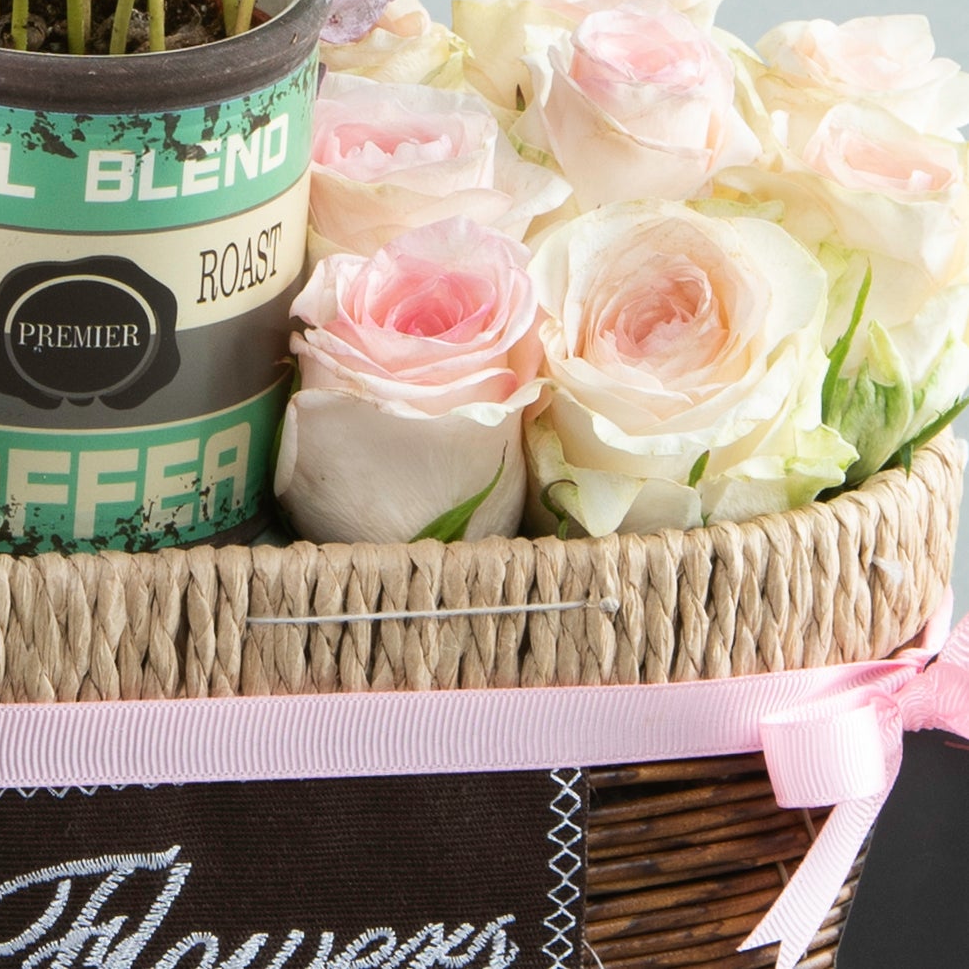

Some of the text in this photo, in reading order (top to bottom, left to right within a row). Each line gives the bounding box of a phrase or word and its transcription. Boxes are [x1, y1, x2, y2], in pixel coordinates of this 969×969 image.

[84, 113, 289, 203] BLEND
[196, 222, 282, 304] ROAST
[17, 321, 141, 349] PREMIER
